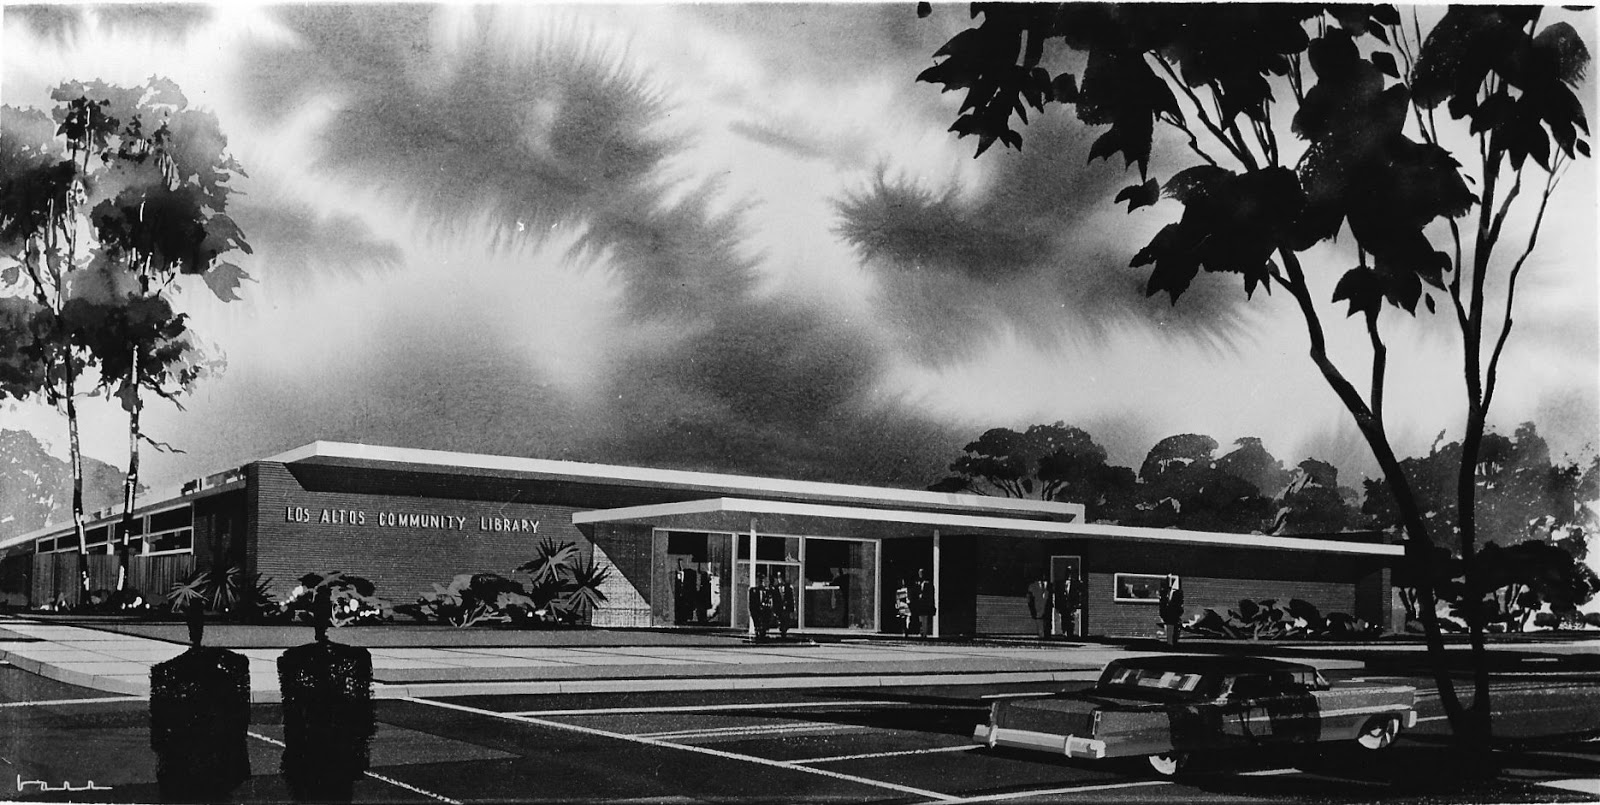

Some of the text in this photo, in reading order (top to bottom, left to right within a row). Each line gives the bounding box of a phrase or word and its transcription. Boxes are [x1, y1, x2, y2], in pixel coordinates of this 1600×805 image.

[286, 506, 540, 534] LOS ALTOS COMMUNITY LIBRARY
